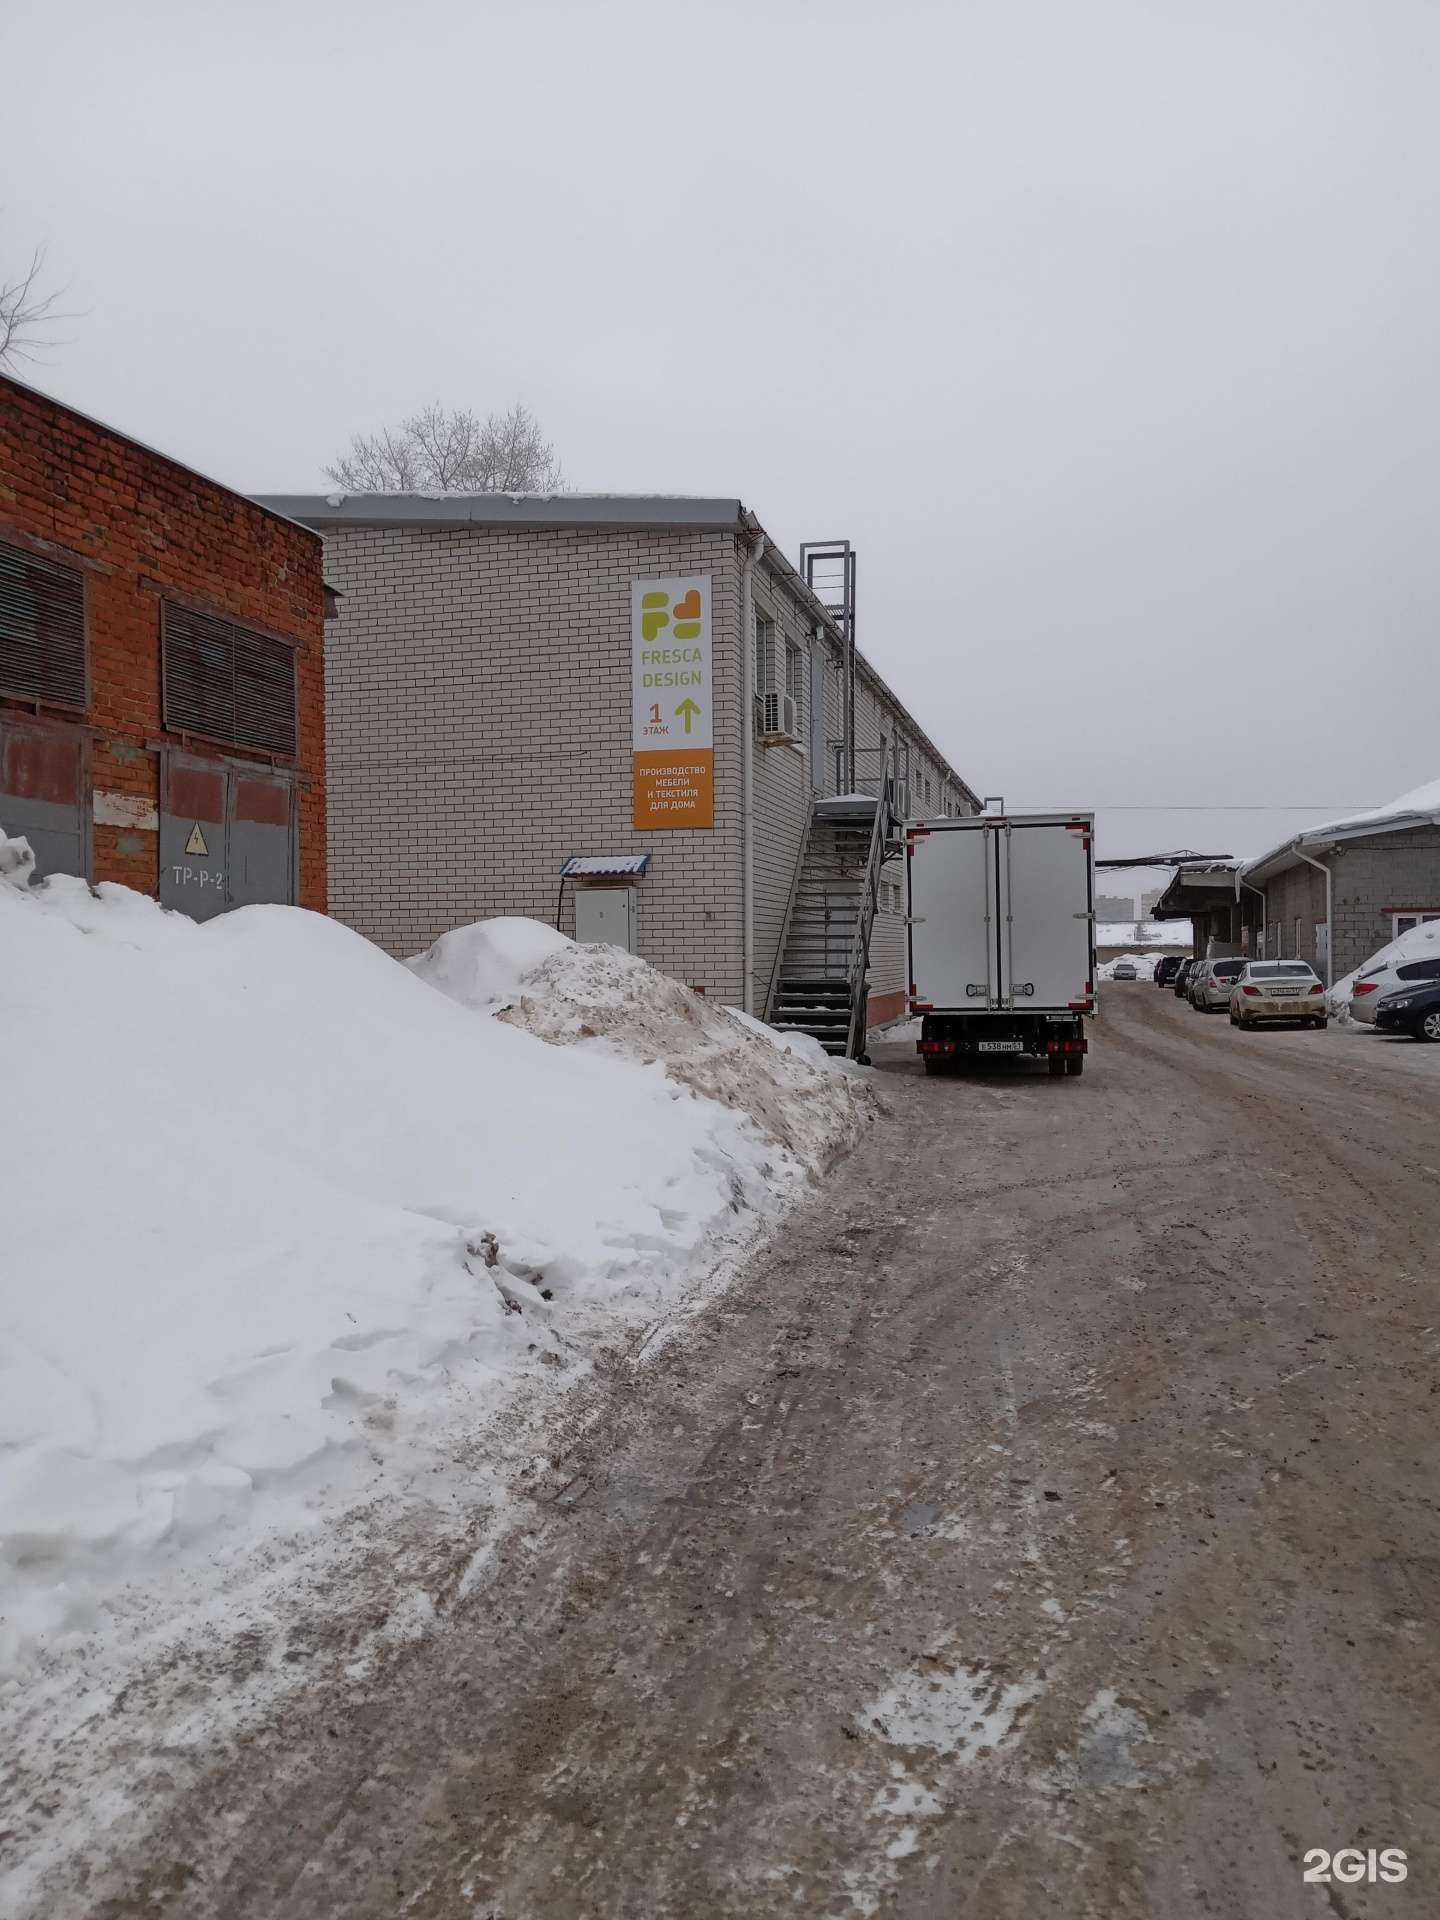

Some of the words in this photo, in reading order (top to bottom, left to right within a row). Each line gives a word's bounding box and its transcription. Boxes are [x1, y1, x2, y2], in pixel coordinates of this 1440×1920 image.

[641, 648, 702, 665] FRESCA
[643, 671, 702, 688] DESIGN
[649, 703, 662, 723] 1
[643, 726, 669, 736] ЭТАЖ
[639, 766, 706, 777] ПРОИЗВОДСТВО
[655, 778, 690, 787] МЕБЕЛИ
[647, 790, 654, 799] И
[655, 789, 698, 798] ТЕКСТИЛЯ
[650, 801, 669, 811] ДЛЯ
[671, 801, 696, 810] ДОМА
